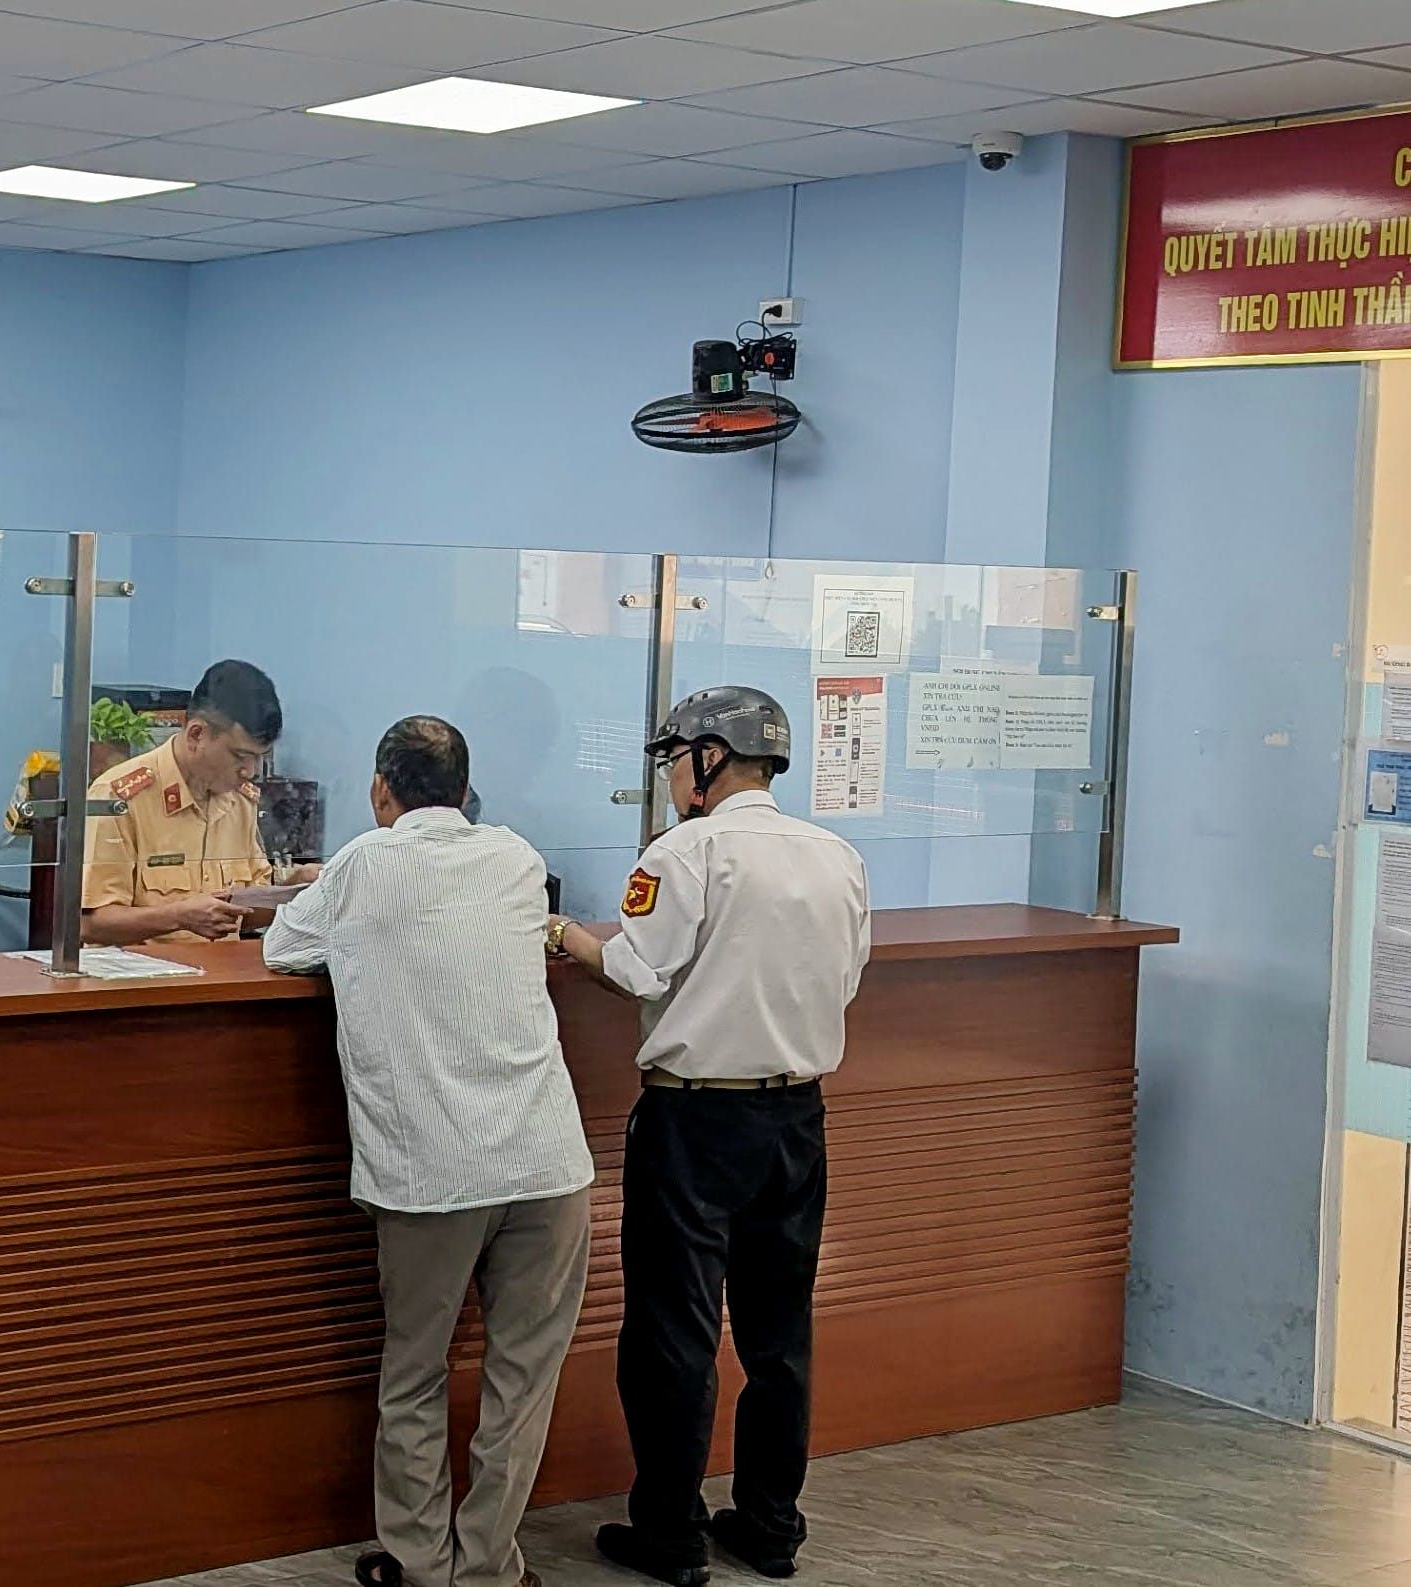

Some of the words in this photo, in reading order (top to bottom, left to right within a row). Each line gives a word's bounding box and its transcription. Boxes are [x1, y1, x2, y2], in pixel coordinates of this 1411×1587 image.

[1164, 220, 1237, 277] QUYẾT
[1244, 220, 1298, 267] TÂM
[1306, 217, 1371, 268] THỰC
[1218, 292, 1279, 333] THEO
[1287, 288, 1346, 329] TINH
